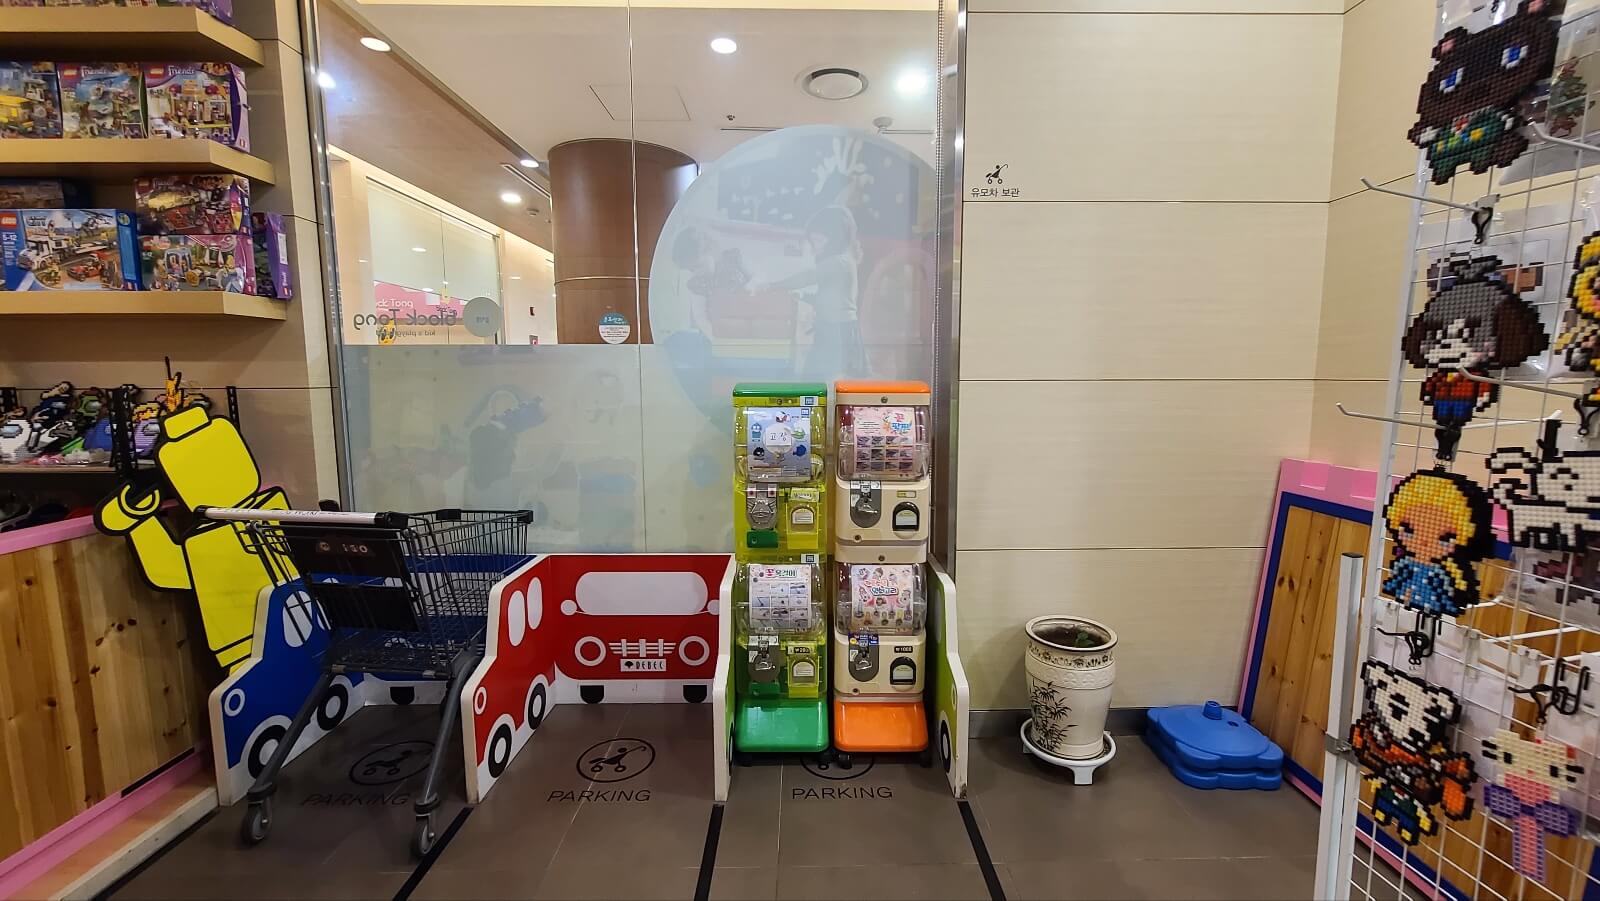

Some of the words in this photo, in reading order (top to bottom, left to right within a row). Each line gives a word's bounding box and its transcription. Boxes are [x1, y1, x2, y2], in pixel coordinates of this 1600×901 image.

[168, 65, 195, 77] Friends
[971, 187, 998, 198] 유모차
[1001, 187, 1020, 198] 보관
[635, 660, 664, 670] DEBEC
[301, 791, 412, 807] PARKING
[546, 788, 651, 802] PARKING
[792, 785, 893, 800] PARKING
